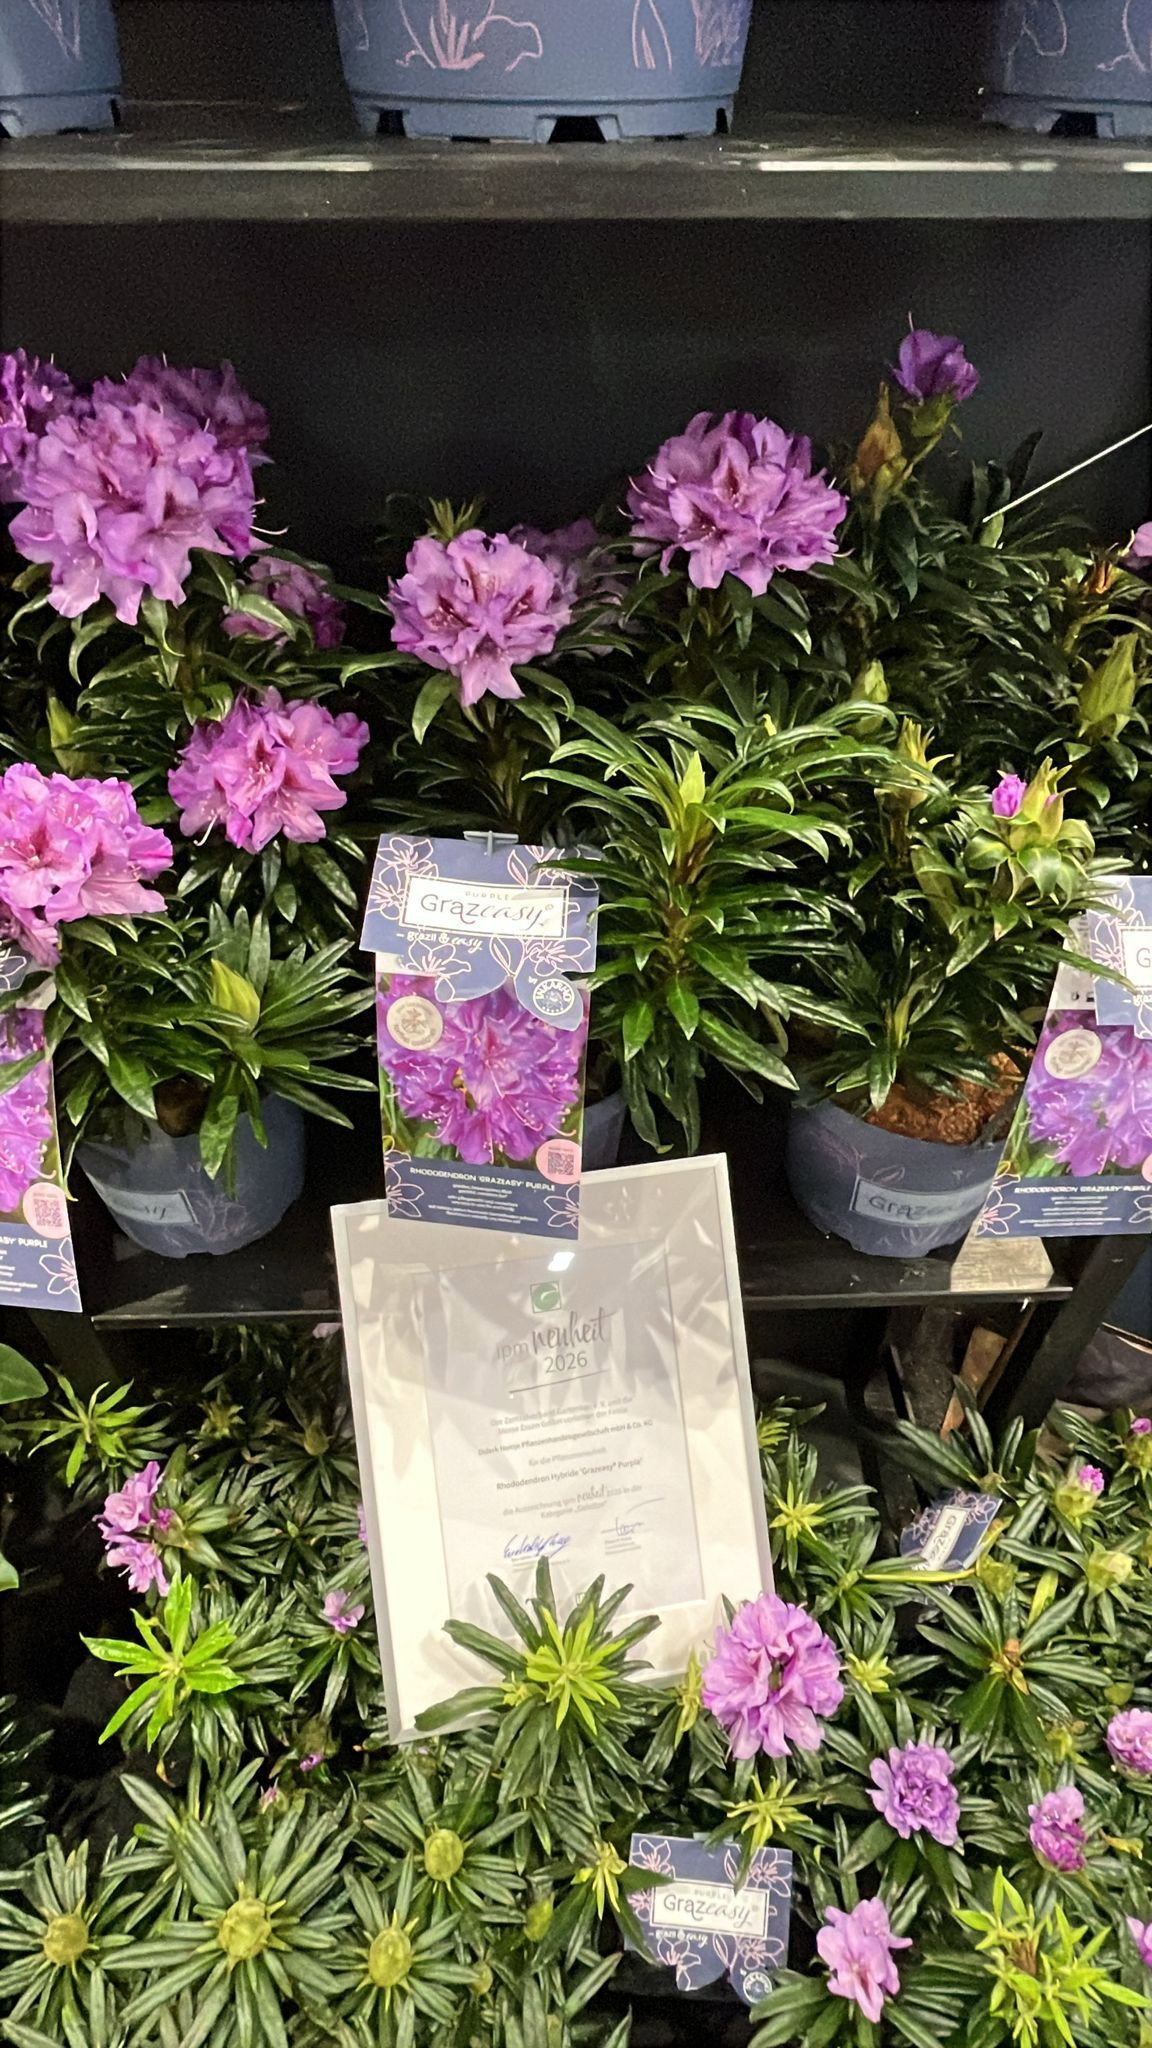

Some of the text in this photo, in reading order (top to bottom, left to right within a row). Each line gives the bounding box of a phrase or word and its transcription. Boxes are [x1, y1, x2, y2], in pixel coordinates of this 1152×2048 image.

[410, 1167, 477, 1181] RHODODENDRON
[525, 1181, 555, 1191] PURPLE
[531, 1306, 617, 1355] neuheit
[543, 1350, 588, 1374] 2026
[496, 1475, 551, 1490] Rhododendron
[551, 1467, 579, 1482] Hybride
